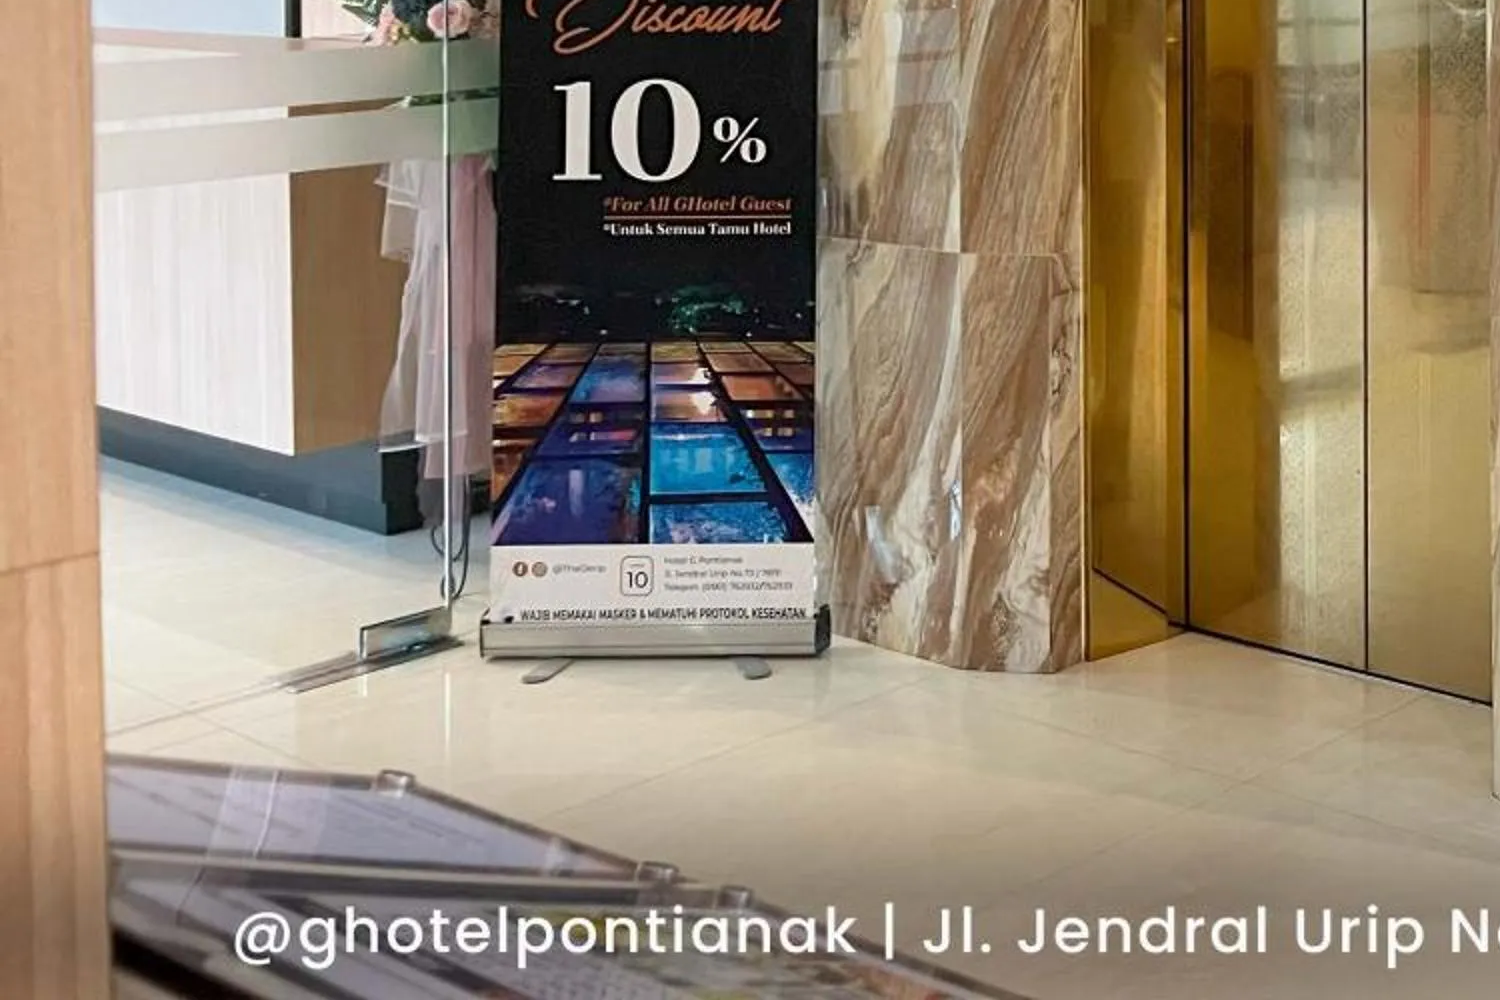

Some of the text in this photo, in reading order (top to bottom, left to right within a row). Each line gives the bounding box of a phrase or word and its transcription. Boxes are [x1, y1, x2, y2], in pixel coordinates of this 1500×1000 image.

[646, 196, 670, 211] All
[673, 195, 737, 211] GHotel
[740, 195, 791, 211] Guest
[656, 222, 705, 235] Semua
[708, 222, 750, 235] Tamu
[753, 221, 791, 235] Hotel
[626, 570, 649, 590] 10
[521, 609, 551, 621] WAJIB
[553, 609, 597, 621] MEMAKAI
[599, 608, 638, 620] MASKER
[700, 607, 750, 620] PROTOKOL
[752, 607, 807, 620] KESEHATAN
